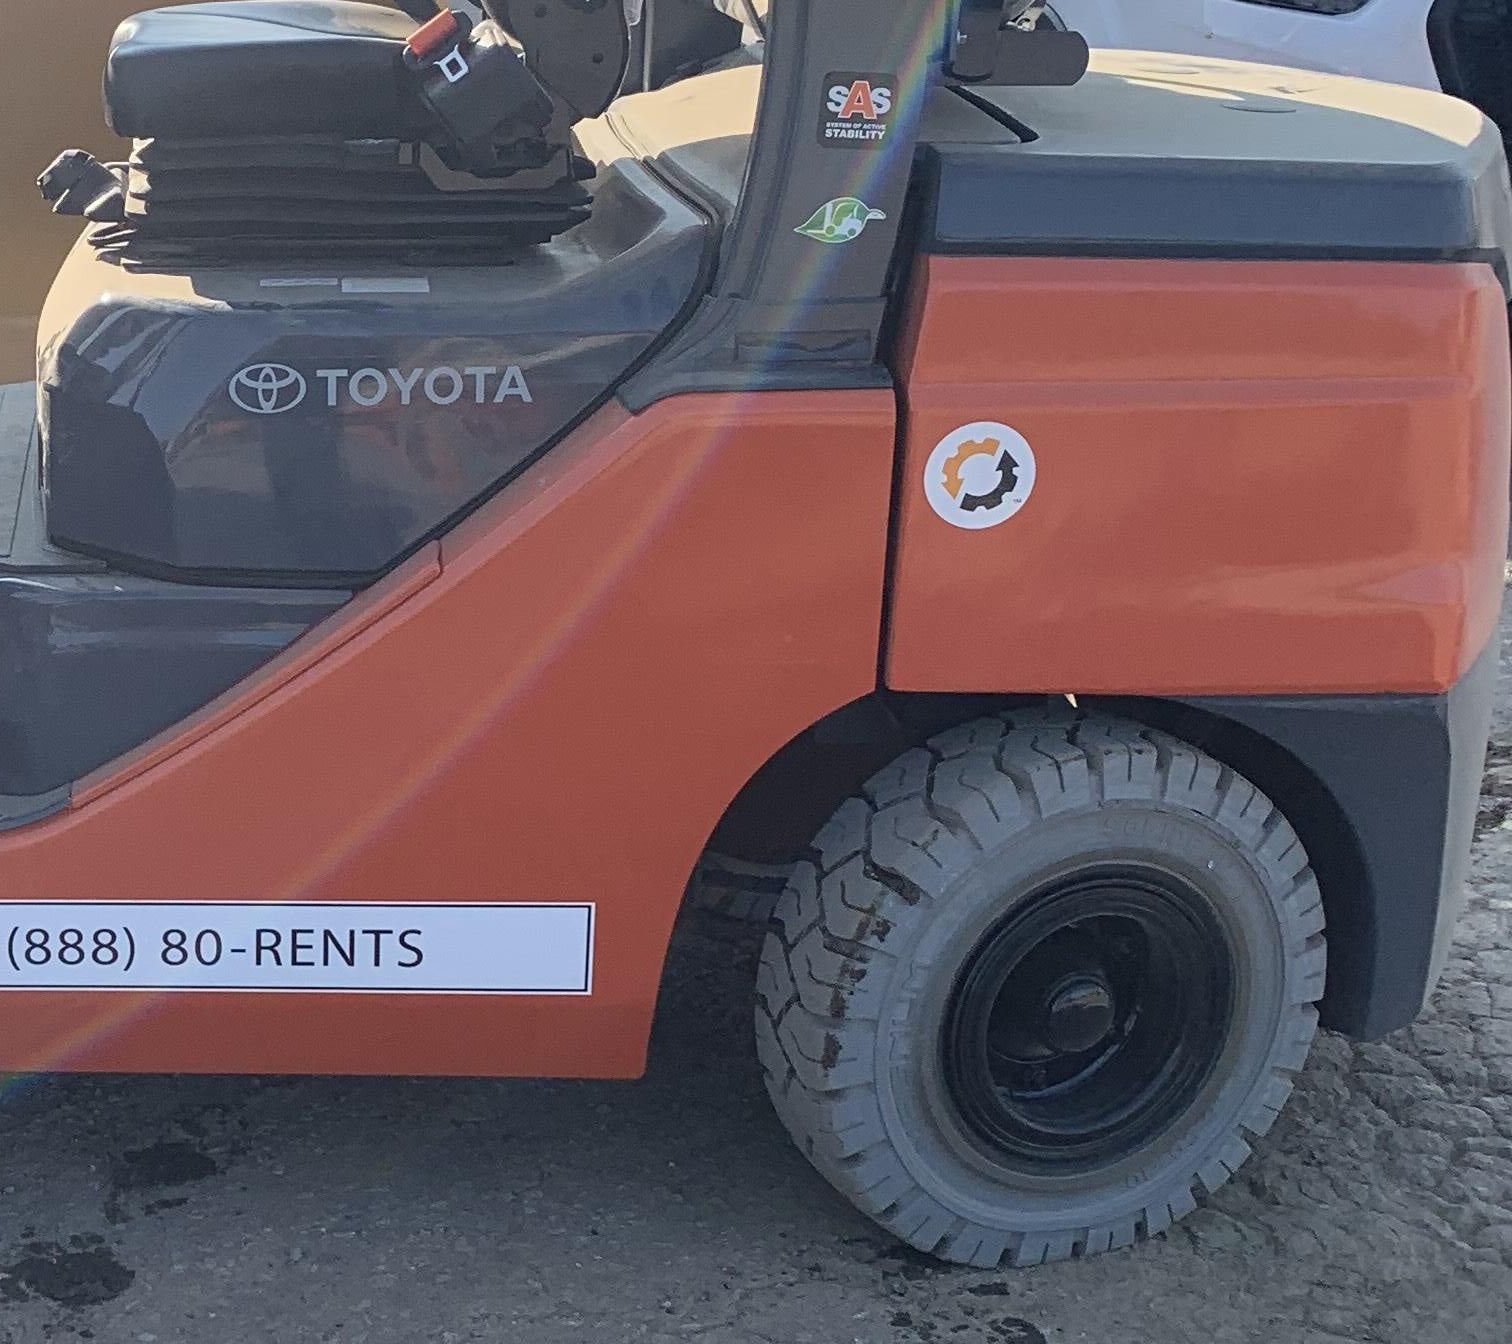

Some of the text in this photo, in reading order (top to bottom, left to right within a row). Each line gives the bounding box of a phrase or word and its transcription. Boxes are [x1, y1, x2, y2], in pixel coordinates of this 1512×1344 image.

[826, 80, 892, 120] SAS
[824, 128, 886, 140] STABILITY
[316, 365, 533, 406] TOYOTA
[7, 926, 424, 971] (888) 80-RENTS
